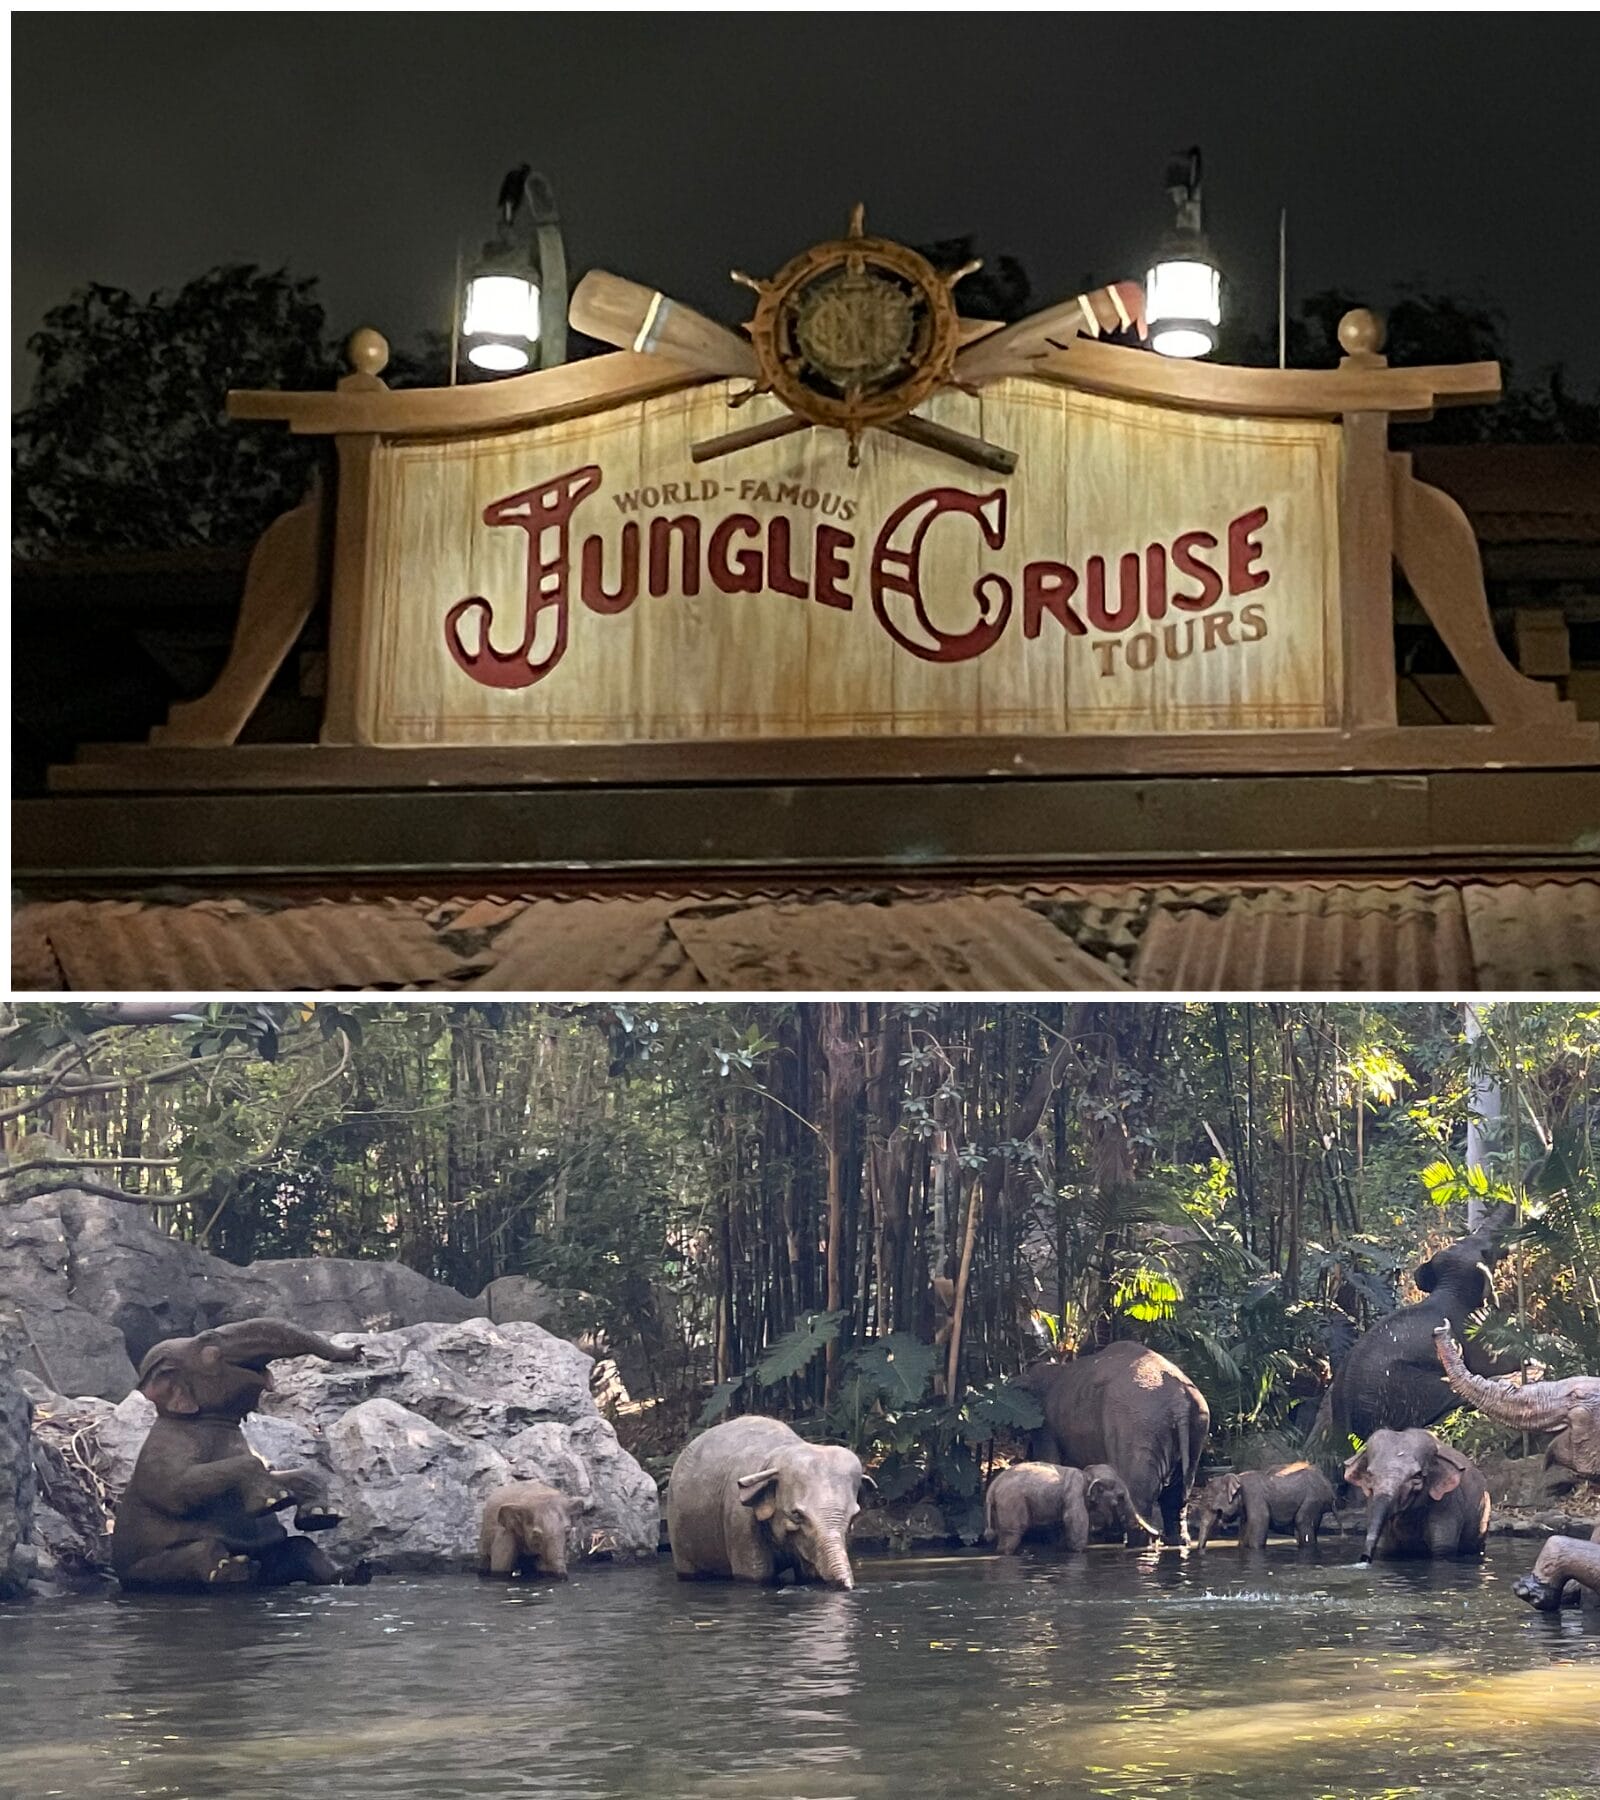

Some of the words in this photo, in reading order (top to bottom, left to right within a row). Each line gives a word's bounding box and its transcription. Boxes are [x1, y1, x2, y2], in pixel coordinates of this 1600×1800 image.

[613, 479, 858, 521] WORLD-FAMOUS
[444, 464, 855, 689] JUNGLE
[870, 486, 1271, 662] CRUISE
[1091, 603, 1270, 677] TOURS
